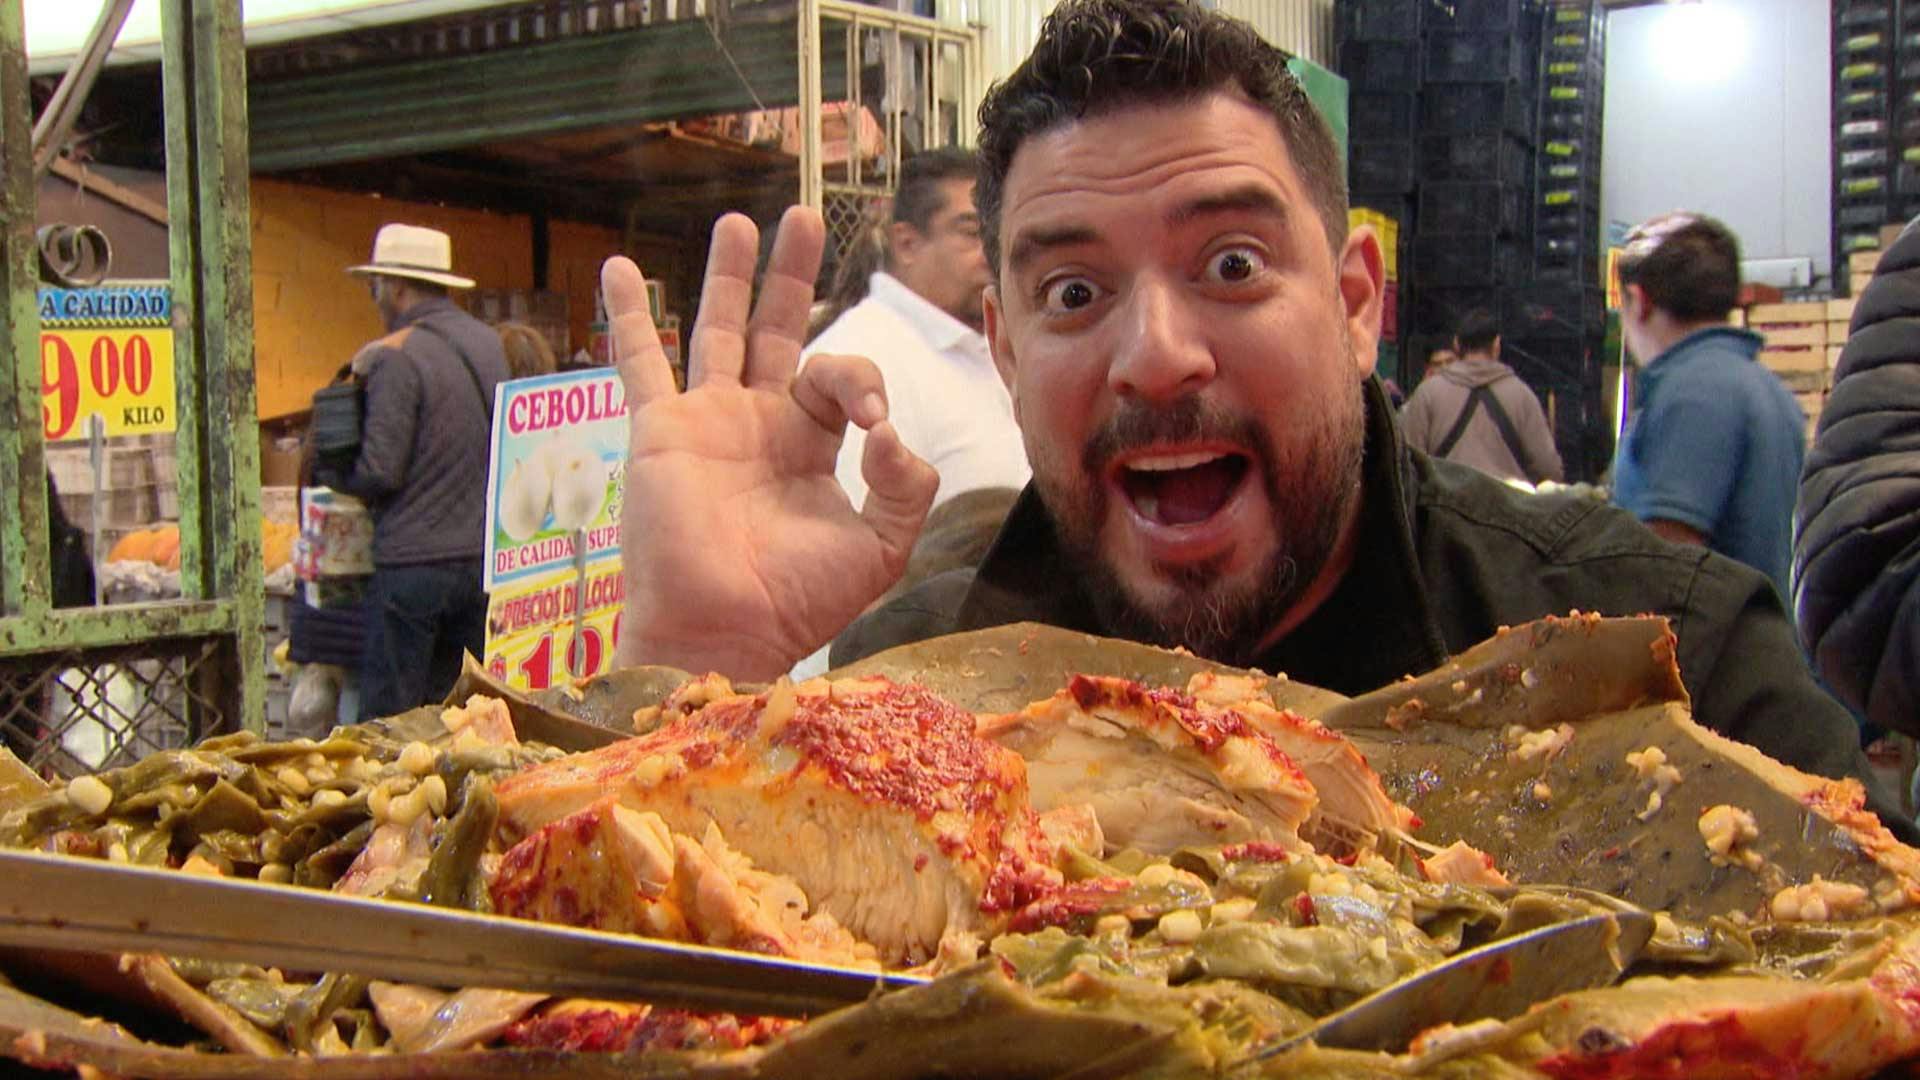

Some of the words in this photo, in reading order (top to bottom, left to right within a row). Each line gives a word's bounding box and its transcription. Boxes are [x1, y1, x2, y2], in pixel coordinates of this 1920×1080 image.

[64, 294, 164, 317] CALIDAD
[123, 406, 164, 426] KILO
[496, 549, 515, 573] DE
[520, 536, 577, 567] CALIDA
[504, 585, 560, 631] PRECIOS
